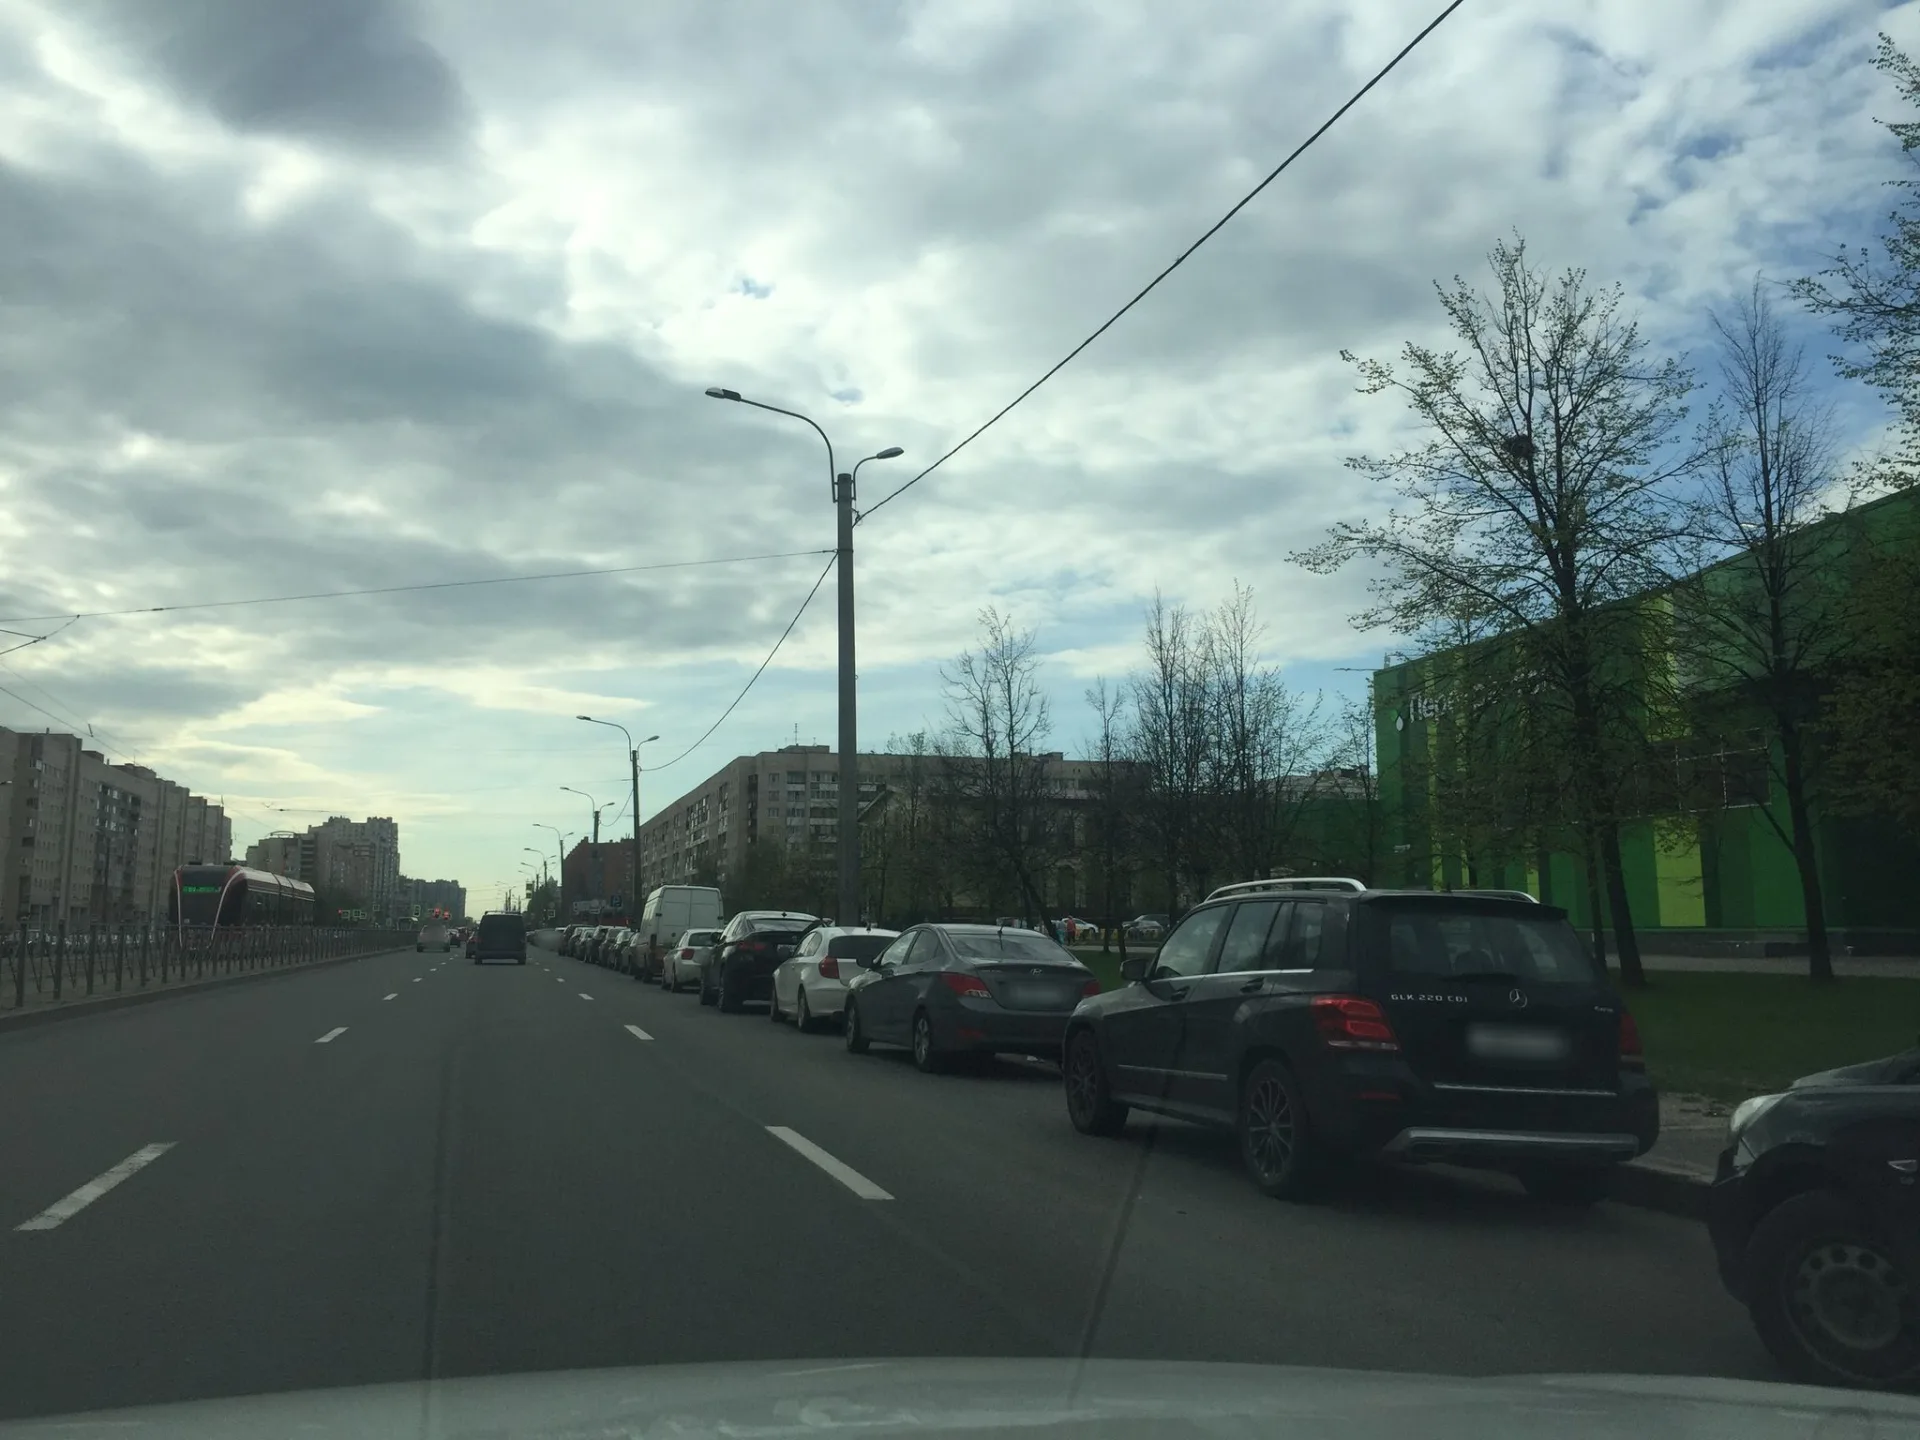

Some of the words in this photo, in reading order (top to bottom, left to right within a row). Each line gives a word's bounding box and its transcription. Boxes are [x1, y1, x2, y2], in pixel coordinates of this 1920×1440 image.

[1390, 993, 1414, 1001] GLK
[1418, 994, 1443, 1002] 220
[1447, 995, 1468, 1003] CDI
